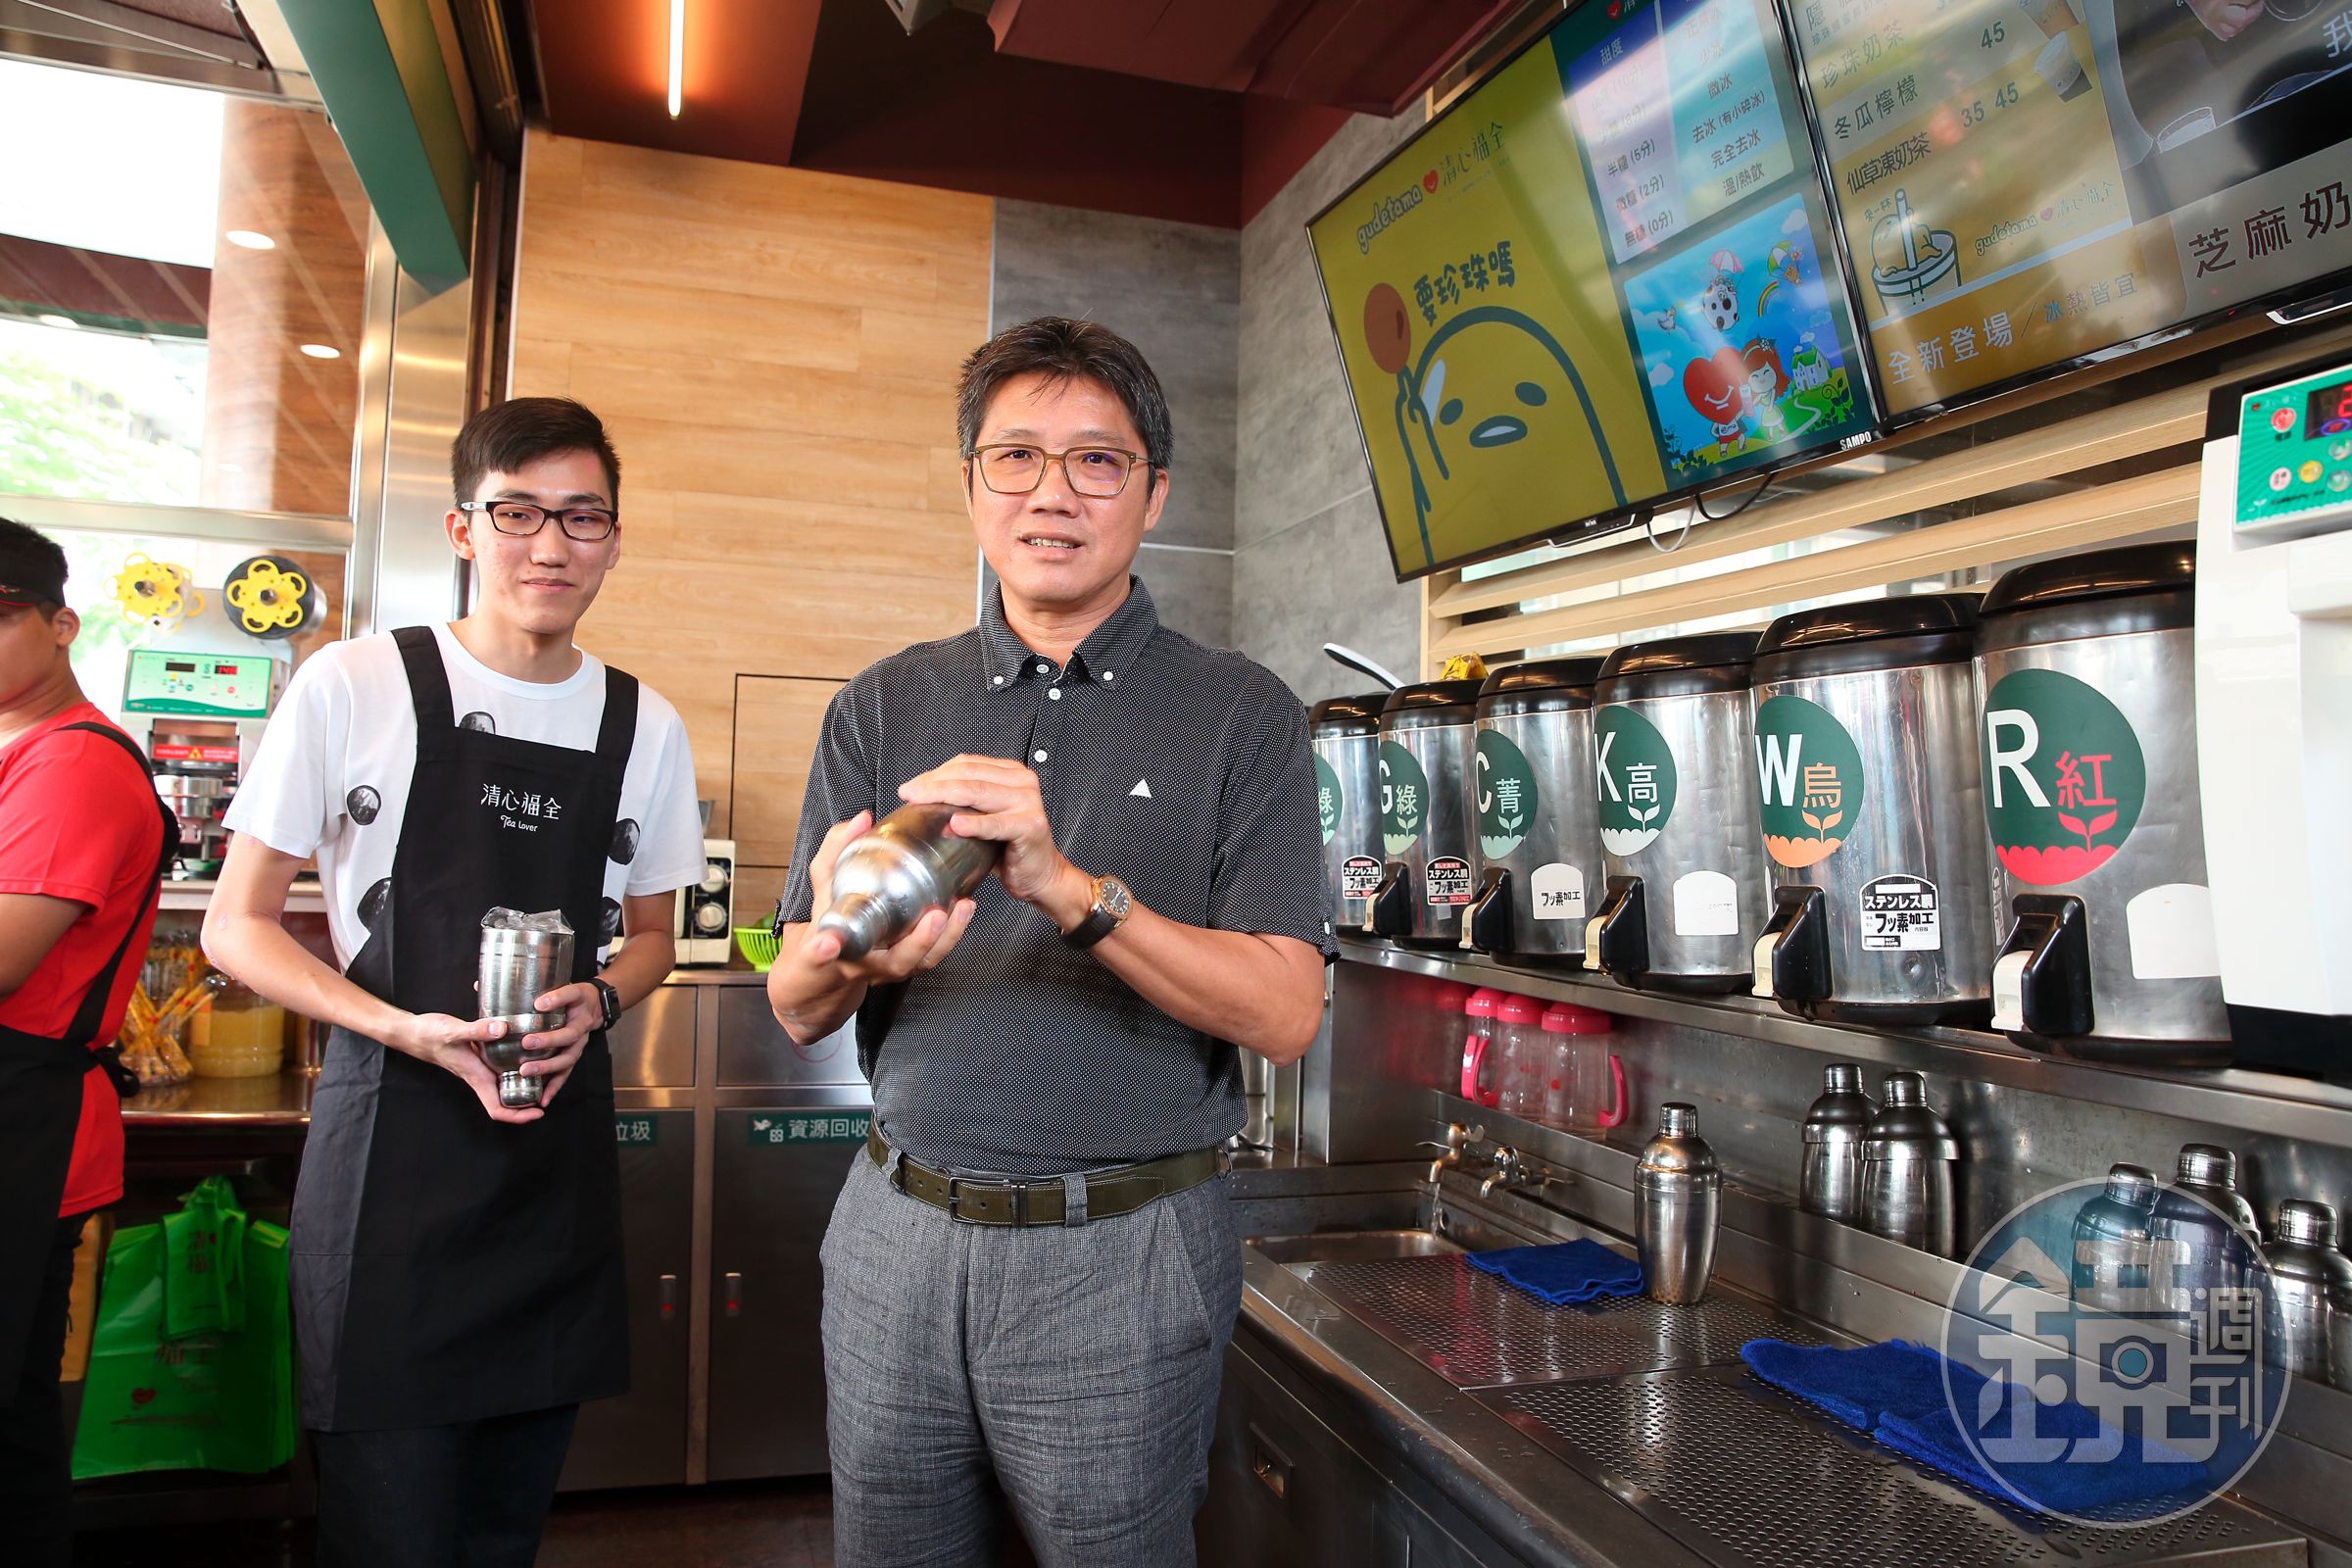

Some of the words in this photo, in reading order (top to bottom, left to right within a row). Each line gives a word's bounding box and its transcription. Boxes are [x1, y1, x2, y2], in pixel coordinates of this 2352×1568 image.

[1599, 37, 1623, 67] 甜度
[1820, 19, 1906, 89] 珍珠奶茶
[1981, 20, 2005, 49] 45
[1707, 73, 1733, 99] 微冰
[1835, 74, 1918, 139] 冬瓜檸檬
[1961, 100, 1984, 128] 35
[1994, 81, 2019, 110] 45
[1692, 118, 1716, 144] 去冰
[1711, 128, 1761, 170] 完全去冰
[1441, 122, 1505, 187] 清心福全
[1846, 131, 1932, 195] 仙草凍奶茶
[1356, 183, 1423, 255] gudetama
[1975, 215, 2038, 256] gudetama
[2188, 180, 2351, 278] 芝麻奶
[1413, 240, 1515, 327] 要珍珠嗎
[1887, 312, 2013, 385] 全新登場
[2043, 271, 2138, 323] 冰熱皆宜
[1839, 431, 1872, 451] SAMPO
[1595, 731, 1622, 803] K
[1754, 733, 1803, 807] W
[1986, 710, 2051, 808] R
[2054, 752, 2117, 809] 紅
[480, 784, 562, 819] 清心福全
[1379, 760, 1393, 813] G
[1396, 784, 1417, 814] 綠
[1476, 752, 1492, 812] C
[1496, 778, 1521, 813] 菁
[1626, 762, 1658, 804] 高
[501, 815, 515, 828] Tea
[1542, 892, 1581, 906] フッ素加工
[1876, 912, 1934, 933] フッ素加工
[789, 1118, 869, 1139] 資源回收
